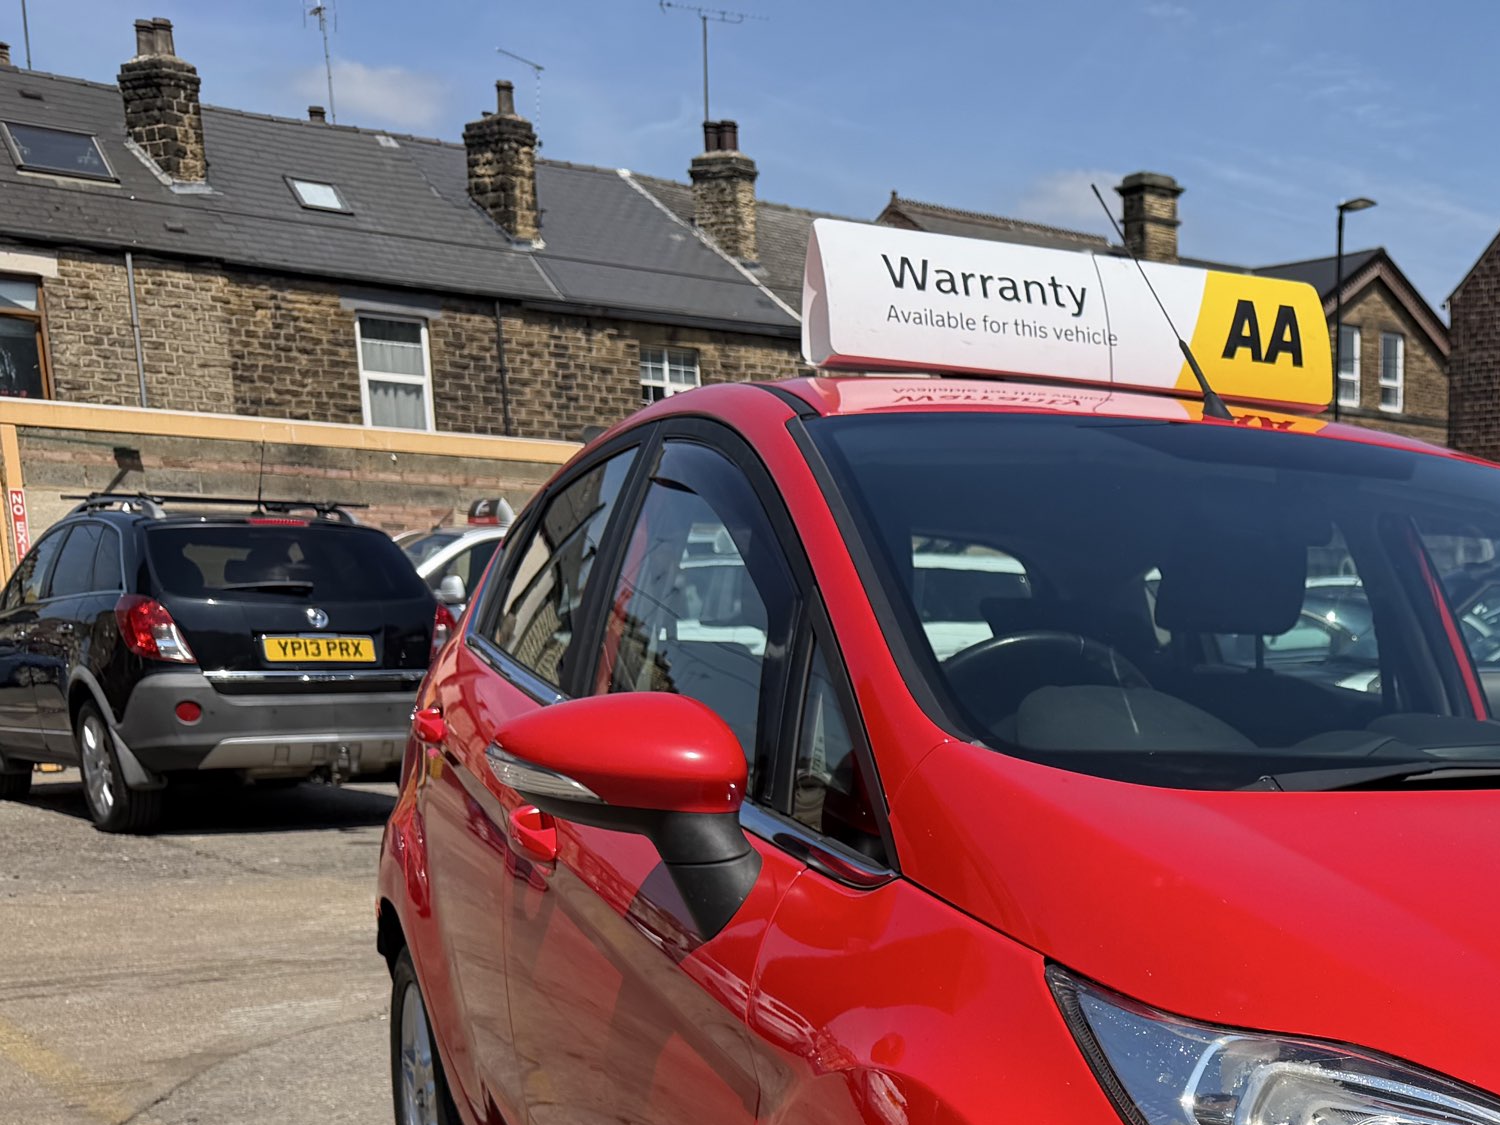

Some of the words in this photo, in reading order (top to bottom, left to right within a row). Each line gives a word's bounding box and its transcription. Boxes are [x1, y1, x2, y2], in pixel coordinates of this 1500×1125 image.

[881, 254, 1086, 317] Warranty
[886, 304, 976, 331] Available
[983, 315, 1008, 334] for
[1014, 318, 1048, 339] this
[1053, 325, 1118, 347] vehicle
[1221, 299, 1304, 368] AA
[12, 493, 24, 516] NO
[16, 521, 26, 558] EXI
[278, 641, 321, 657] YP13
[326, 641, 363, 657] PRX
